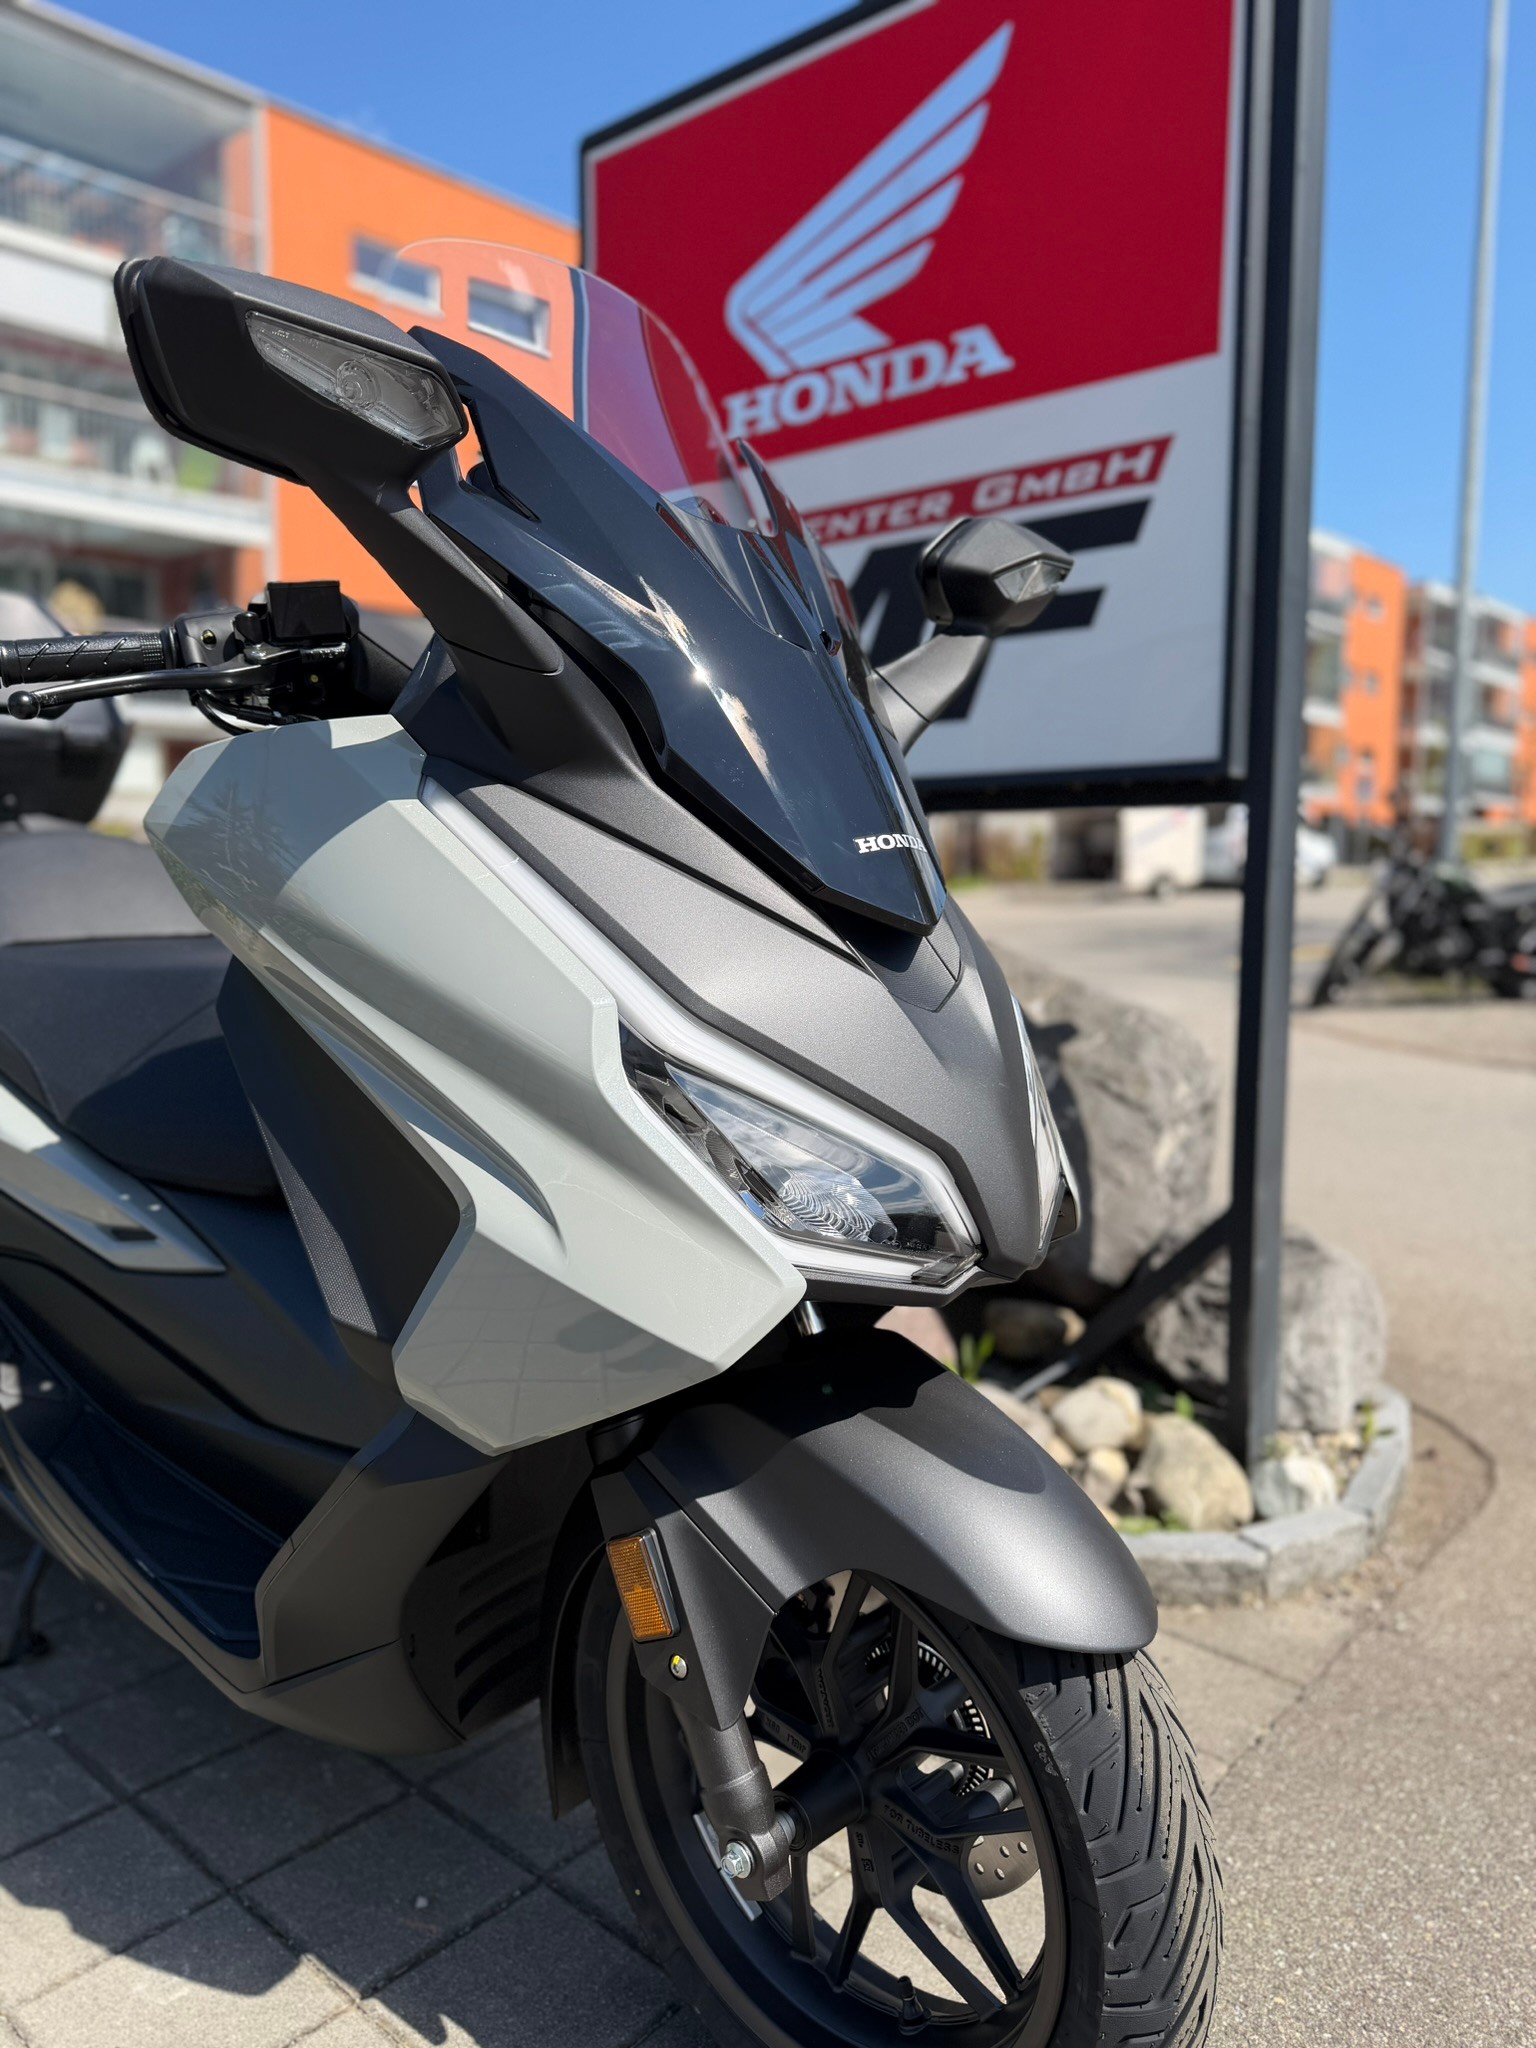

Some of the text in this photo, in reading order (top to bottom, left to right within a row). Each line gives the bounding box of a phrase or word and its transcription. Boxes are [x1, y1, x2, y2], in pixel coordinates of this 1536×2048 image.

[720, 324, 1015, 441] HONDA
[803, 493, 954, 542] ENTER
[854, 833, 928, 854] HONDA
[906, 1819, 961, 1856] TUBELESS
